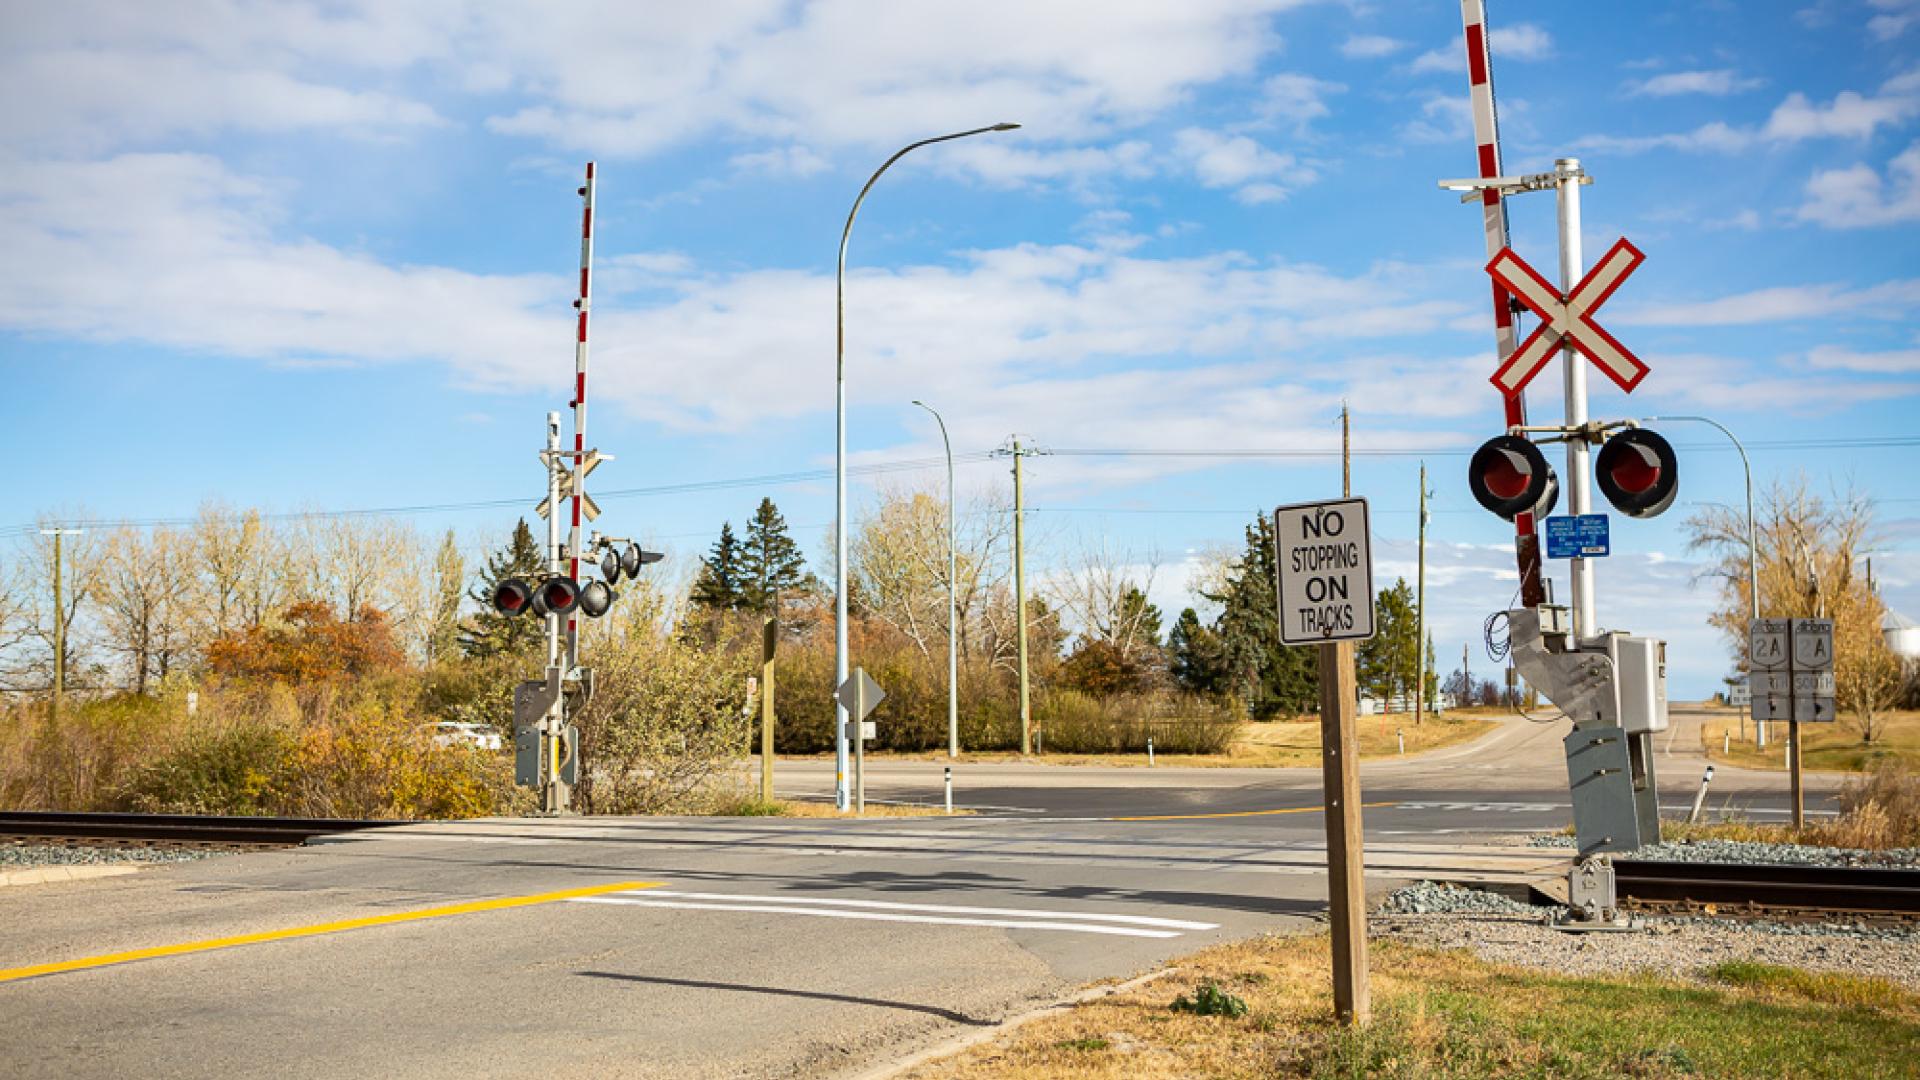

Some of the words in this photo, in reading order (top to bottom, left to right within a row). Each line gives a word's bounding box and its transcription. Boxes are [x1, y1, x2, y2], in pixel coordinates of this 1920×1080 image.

[1302, 511, 1344, 539] NO
[1291, 542, 1358, 573] STOPPING
[1305, 575, 1349, 603] ON
[1298, 604, 1354, 633] TRACKS
[1756, 637, 1780, 657] 2A
